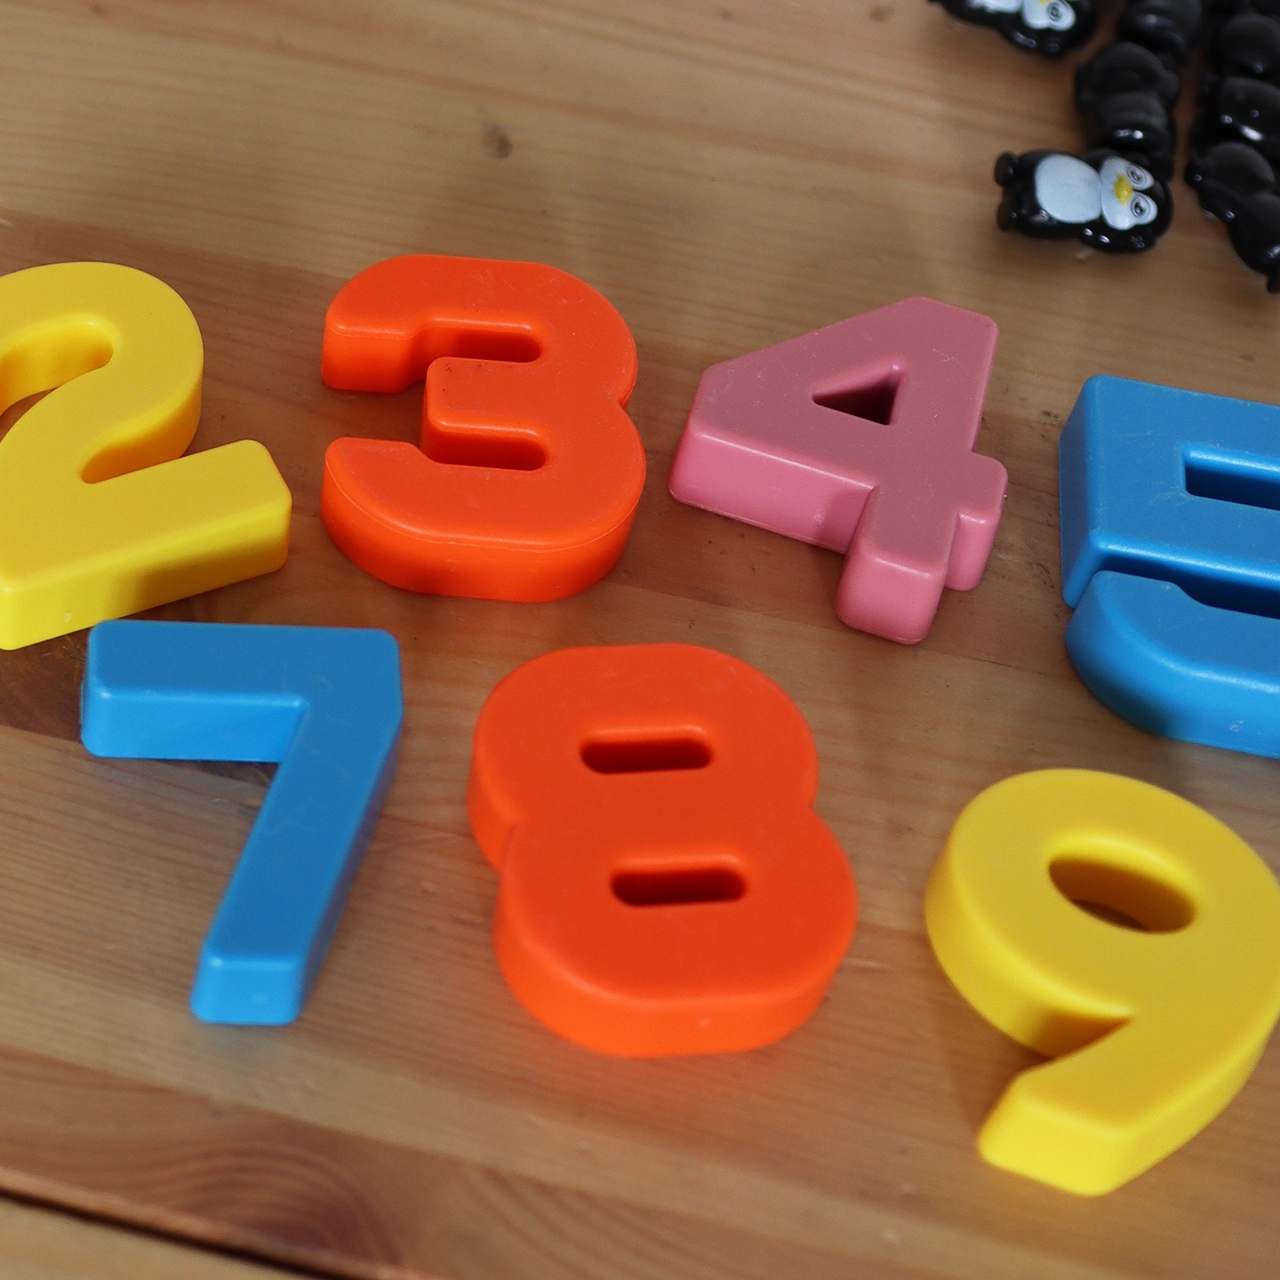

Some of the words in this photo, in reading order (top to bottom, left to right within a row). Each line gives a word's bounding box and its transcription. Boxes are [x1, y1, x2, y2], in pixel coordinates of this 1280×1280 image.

[321, 253, 647, 603] 3
[669, 295, 1009, 645] 4
[80, 619, 403, 1026] 7
[468, 642, 858, 1058] 8
[924, 767, 1280, 1197] 9
